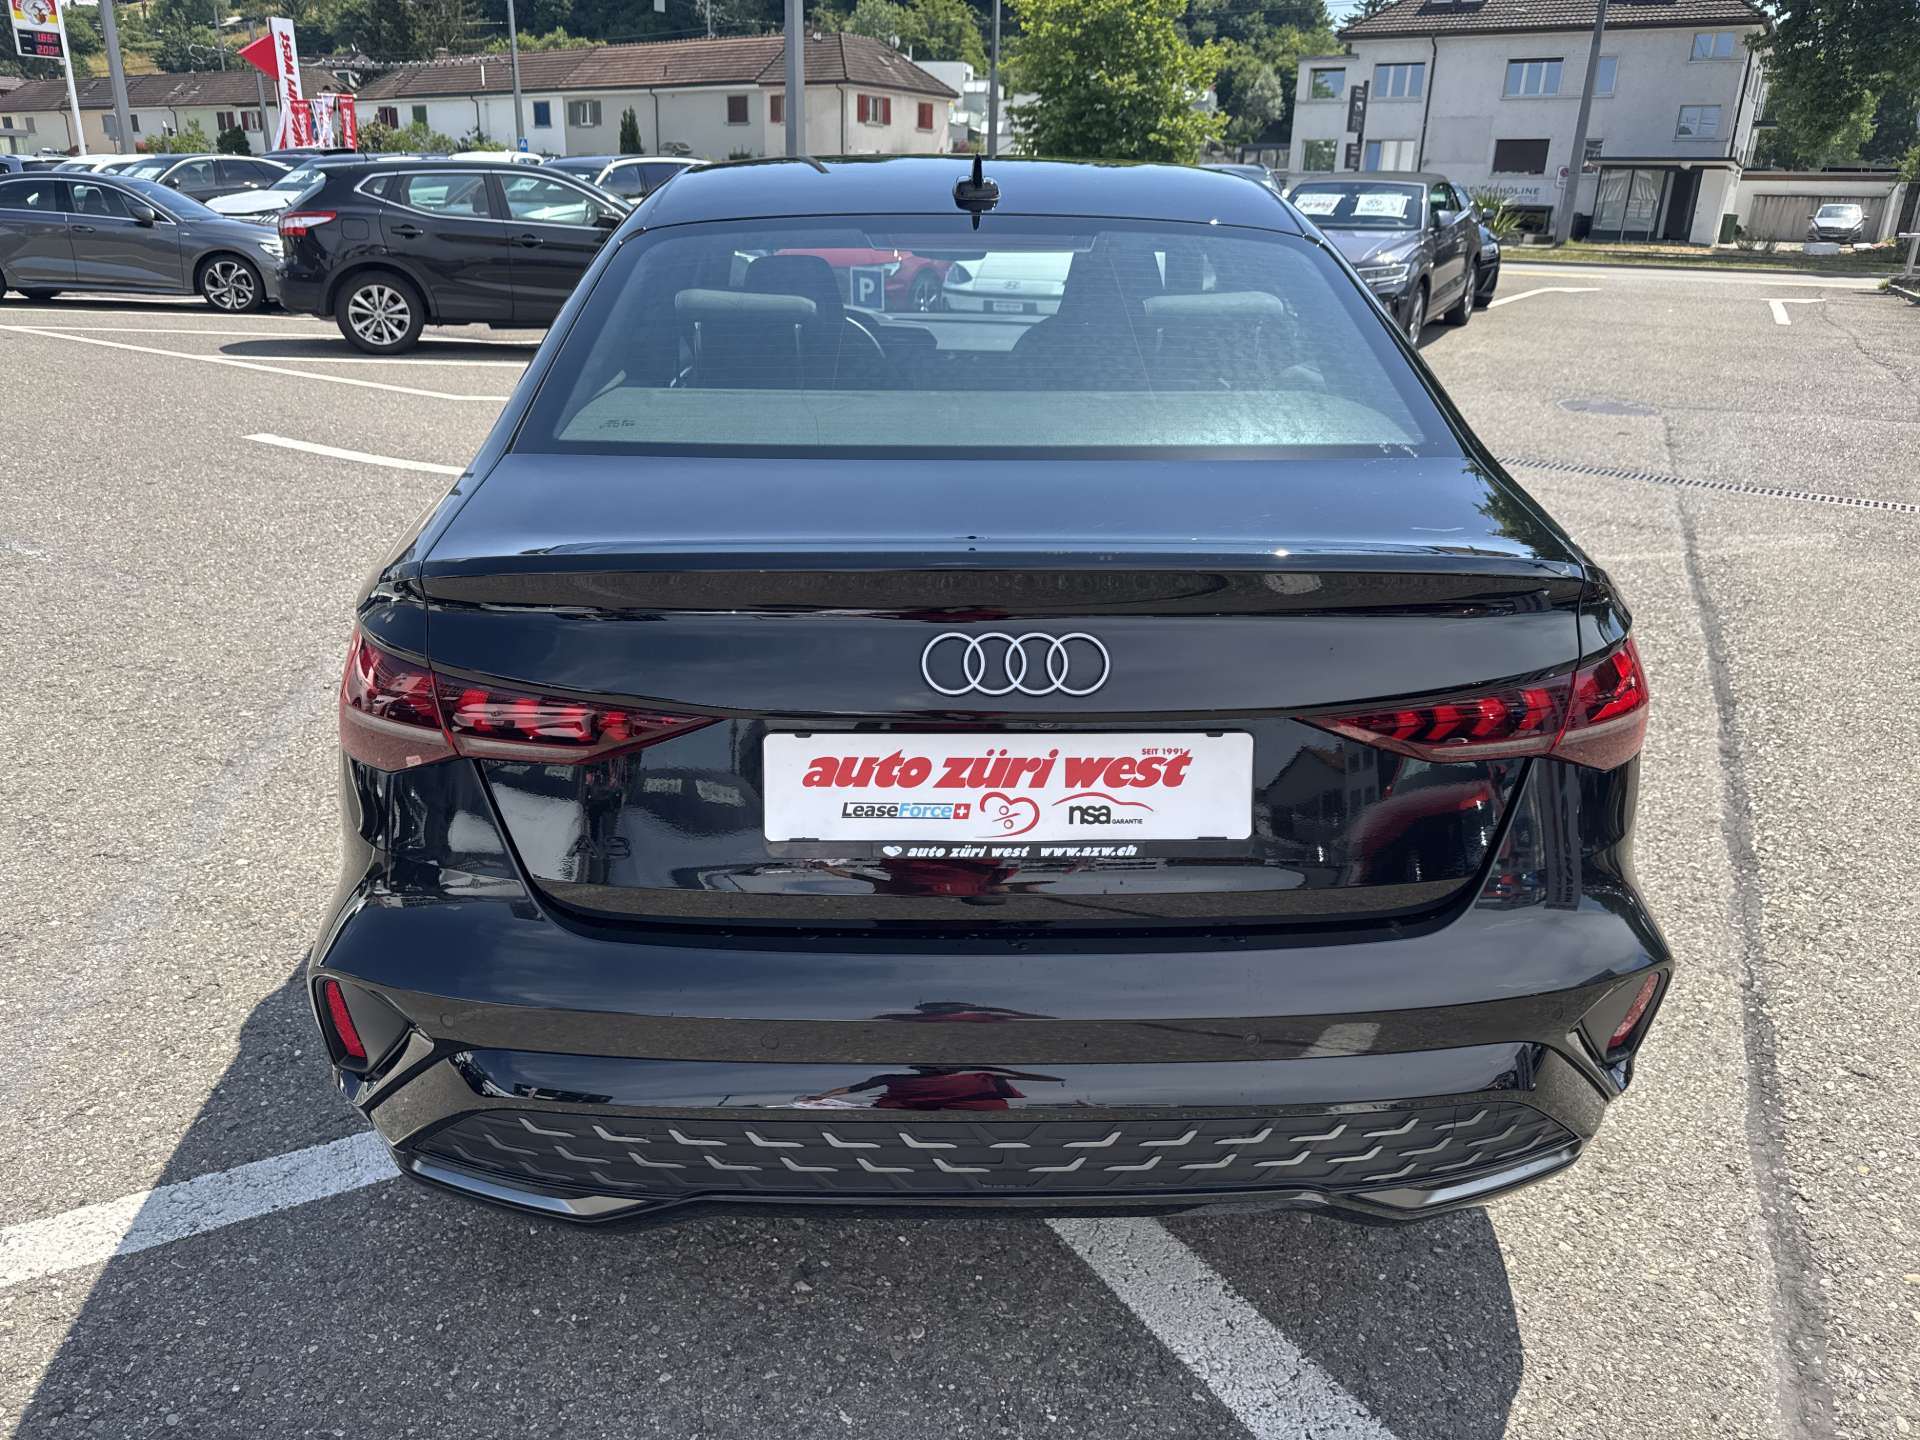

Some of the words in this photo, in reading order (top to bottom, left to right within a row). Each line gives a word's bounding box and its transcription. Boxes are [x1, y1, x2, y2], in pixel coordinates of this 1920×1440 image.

[279, 31, 296, 75] west
[859, 277, 875, 302] P
[1141, 748, 1159, 756] SEIT
[802, 749, 932, 788] auto
[932, 749, 1059, 788] züri
[1065, 749, 1193, 788] west
[841, 802, 953, 818] LeaseForce
[1068, 805, 1111, 825] nsa
[566, 834, 631, 859] A3
[907, 846, 945, 857] auto
[950, 845, 986, 857] züri
[991, 846, 1030, 857] west
[1040, 844, 1138, 857] www.azw.ch
